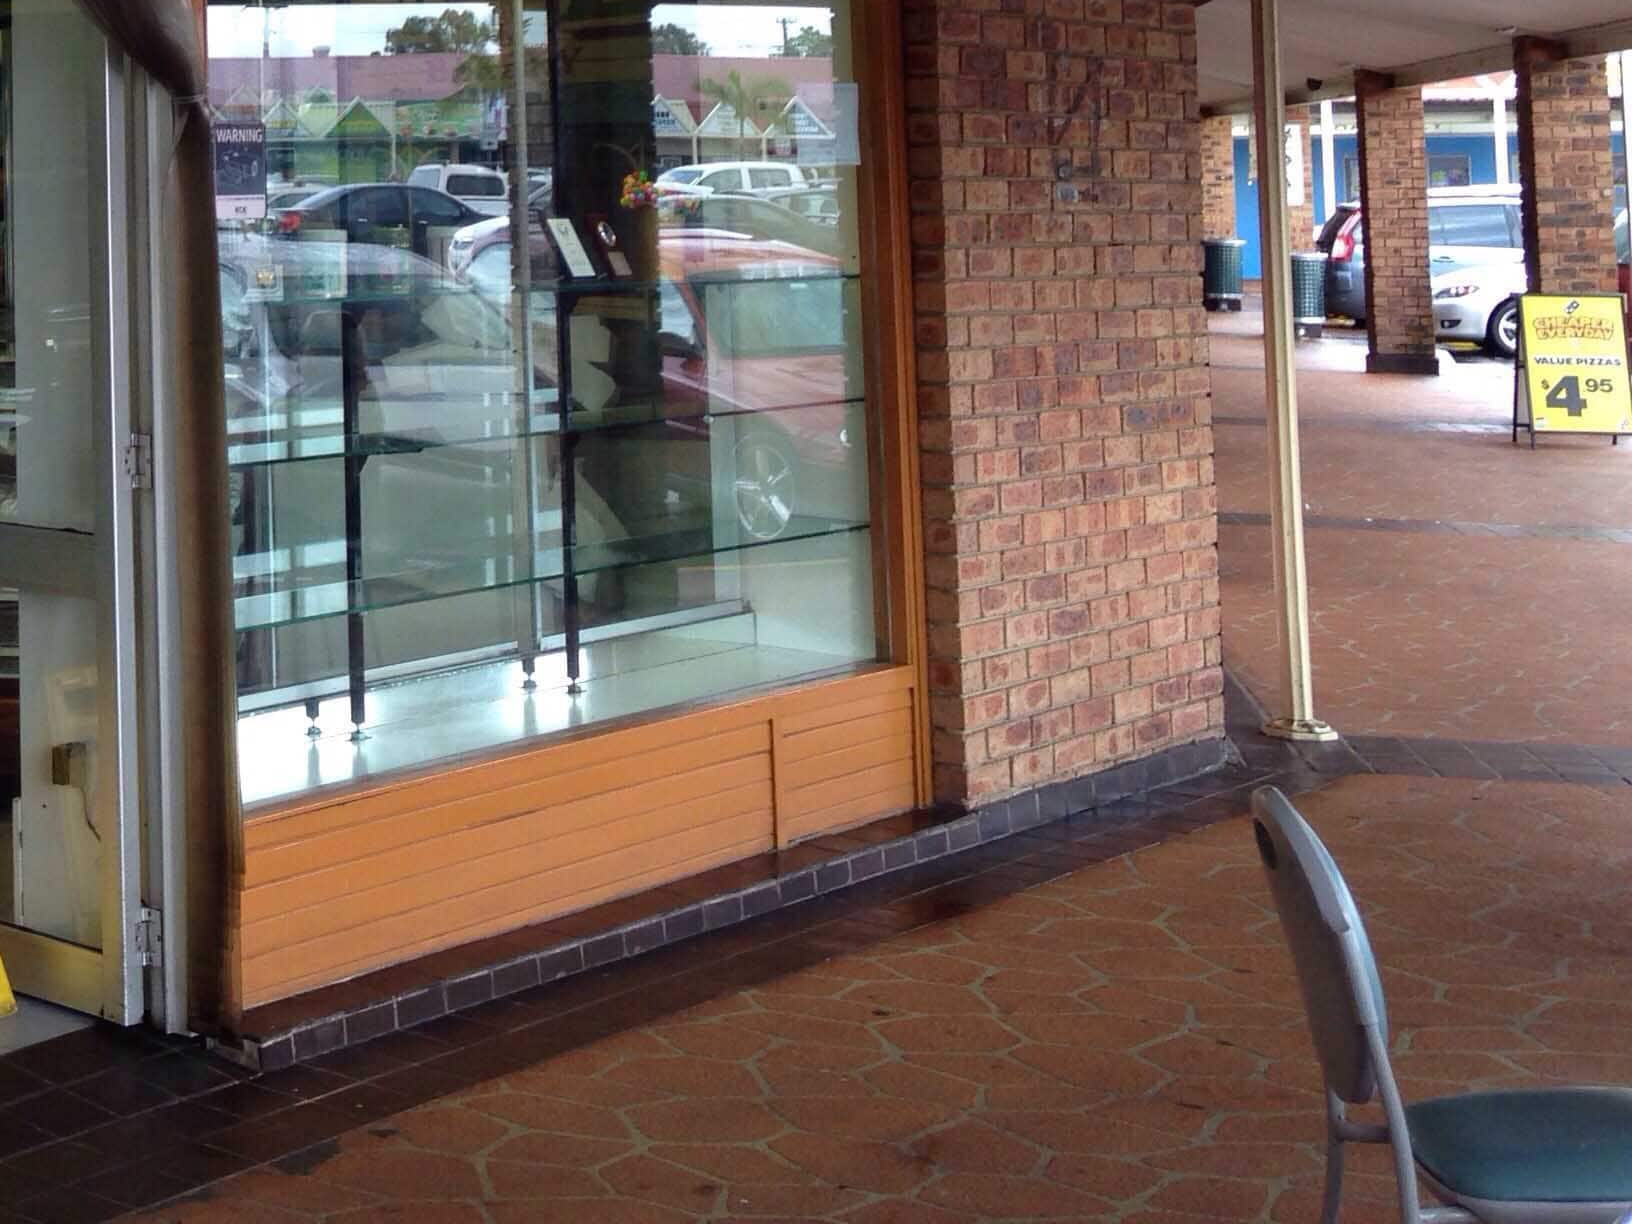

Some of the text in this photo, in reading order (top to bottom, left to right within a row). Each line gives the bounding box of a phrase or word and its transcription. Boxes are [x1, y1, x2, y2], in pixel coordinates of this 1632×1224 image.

[216, 128, 263, 144] WARNING
[1535, 328, 1614, 340] EVERYDAY
[1534, 356, 1622, 366] VALUE PIZZAS
